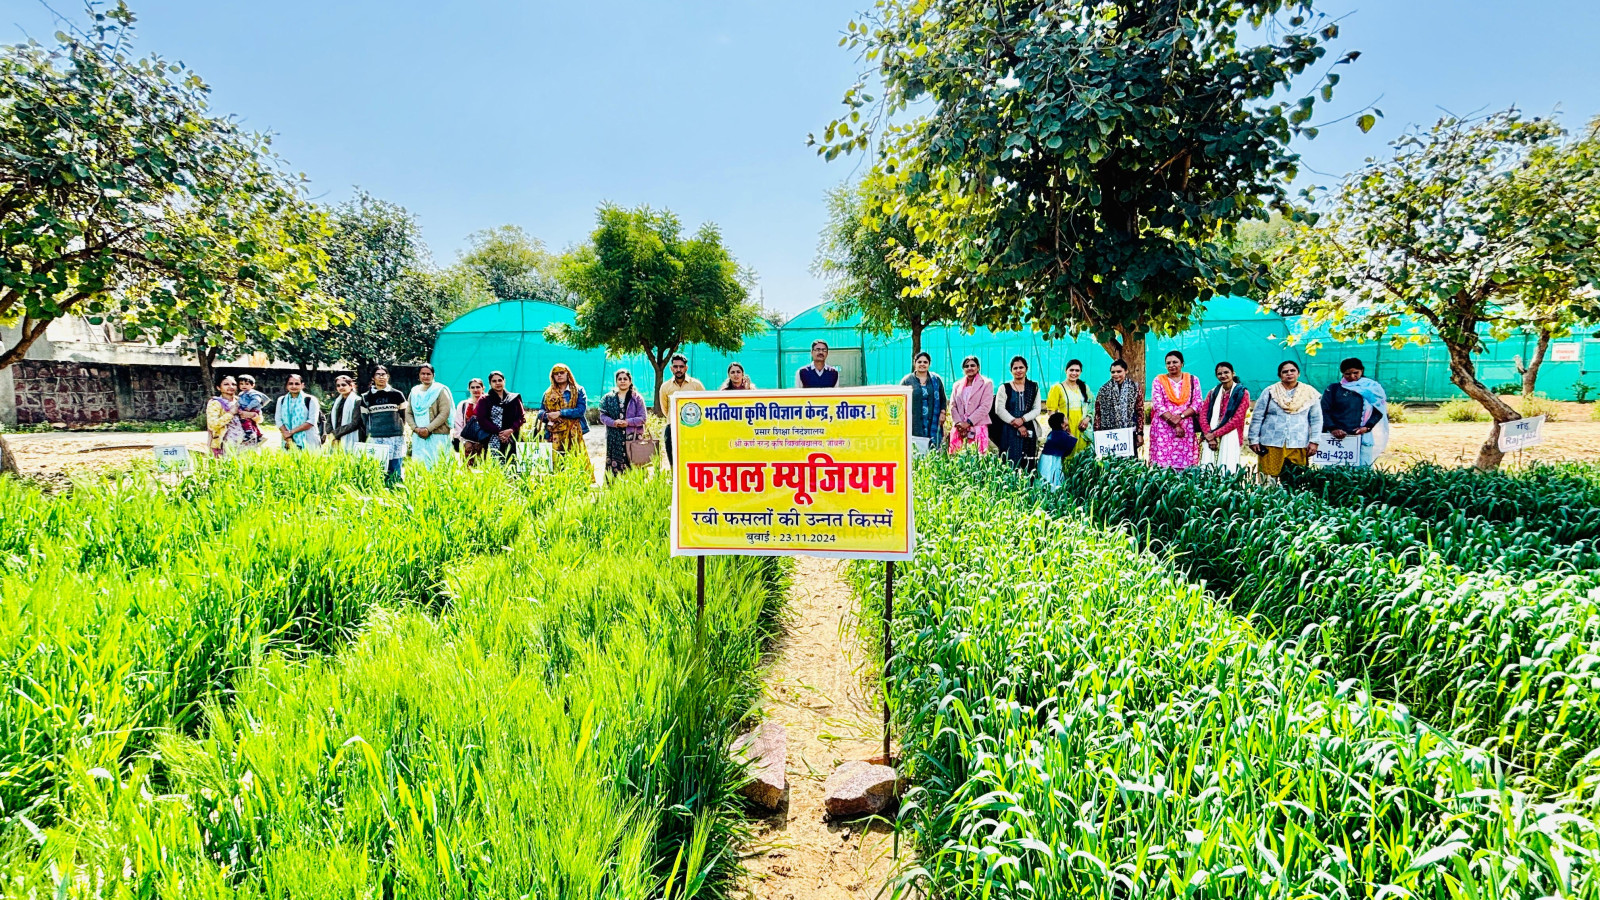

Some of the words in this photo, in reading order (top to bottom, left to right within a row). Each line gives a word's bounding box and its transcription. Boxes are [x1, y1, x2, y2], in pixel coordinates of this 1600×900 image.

[705, 403, 743, 421] भरतिया
[745, 402, 767, 425] कृषि
[769, 402, 803, 420] विज्ञान
[805, 401, 833, 423] केन्द्र,
[754, 428, 771, 436] प्रसार
[772, 425, 790, 436] शिक्षा
[792, 425, 824, 435] निदेशालय
[1317, 450, 1353, 460] Raj-4238
[687, 463, 767, 492] फसल
[771, 453, 897, 505] म्यूजियम
[691, 507, 719, 526] रबी
[723, 507, 774, 526] फसलों
[777, 508, 800, 526] की
[804, 513, 844, 526] उन्नत
[847, 508, 893, 528] किस्में
[746, 530, 770, 544] बुवाई
[780, 533, 836, 543] 23.11.2024
